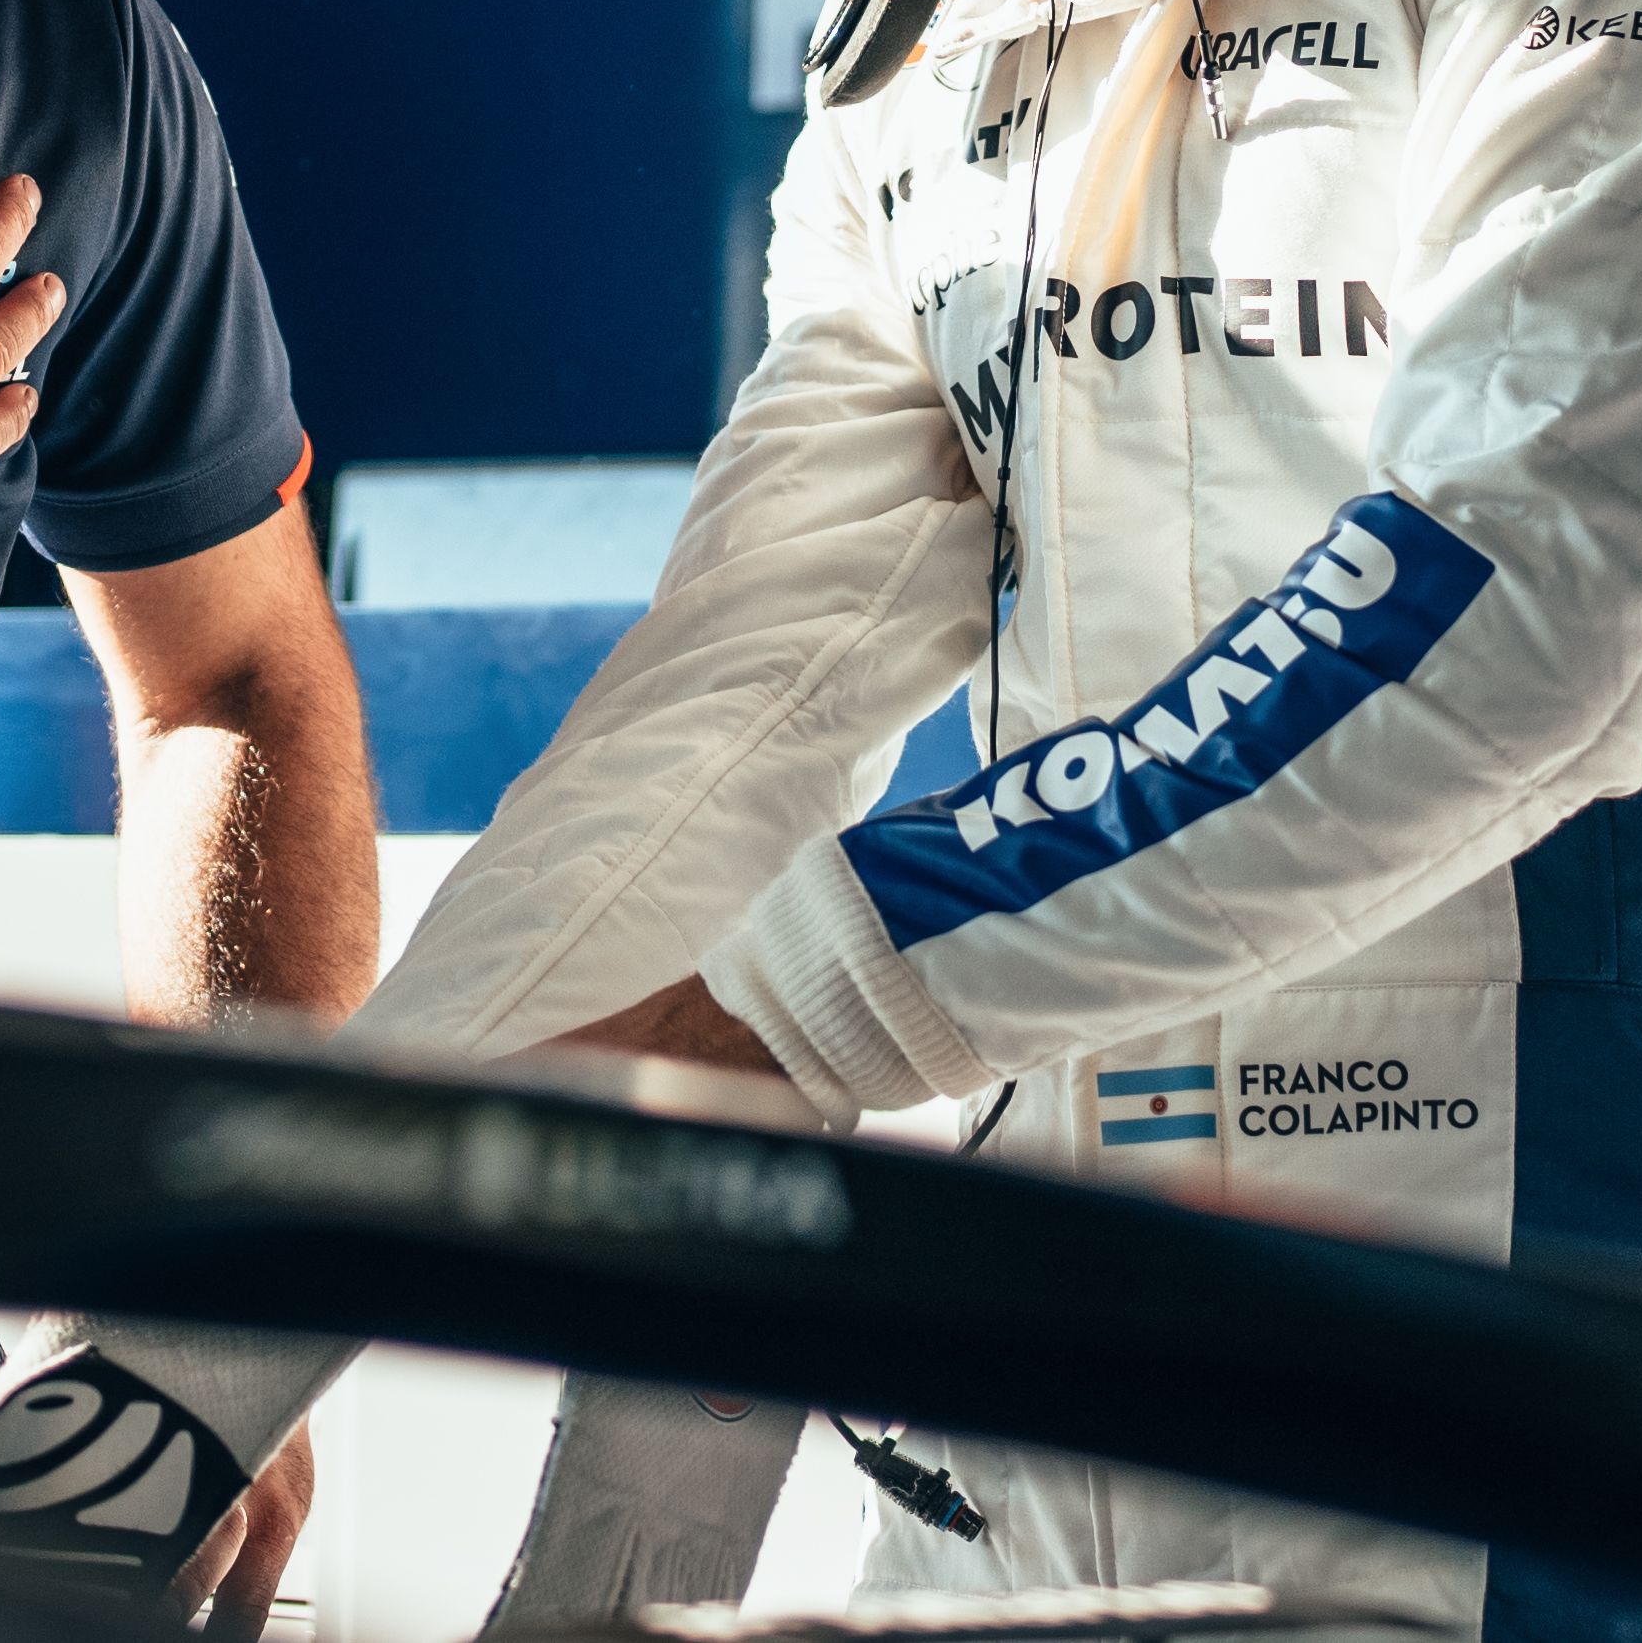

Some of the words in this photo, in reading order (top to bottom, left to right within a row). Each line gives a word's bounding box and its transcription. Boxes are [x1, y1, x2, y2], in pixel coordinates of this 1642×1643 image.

[1181, 21, 1380, 80] URACELL
[1239, 1059, 1409, 1096] FRANCO
[1239, 1098, 1479, 1137] COLAPINTO
